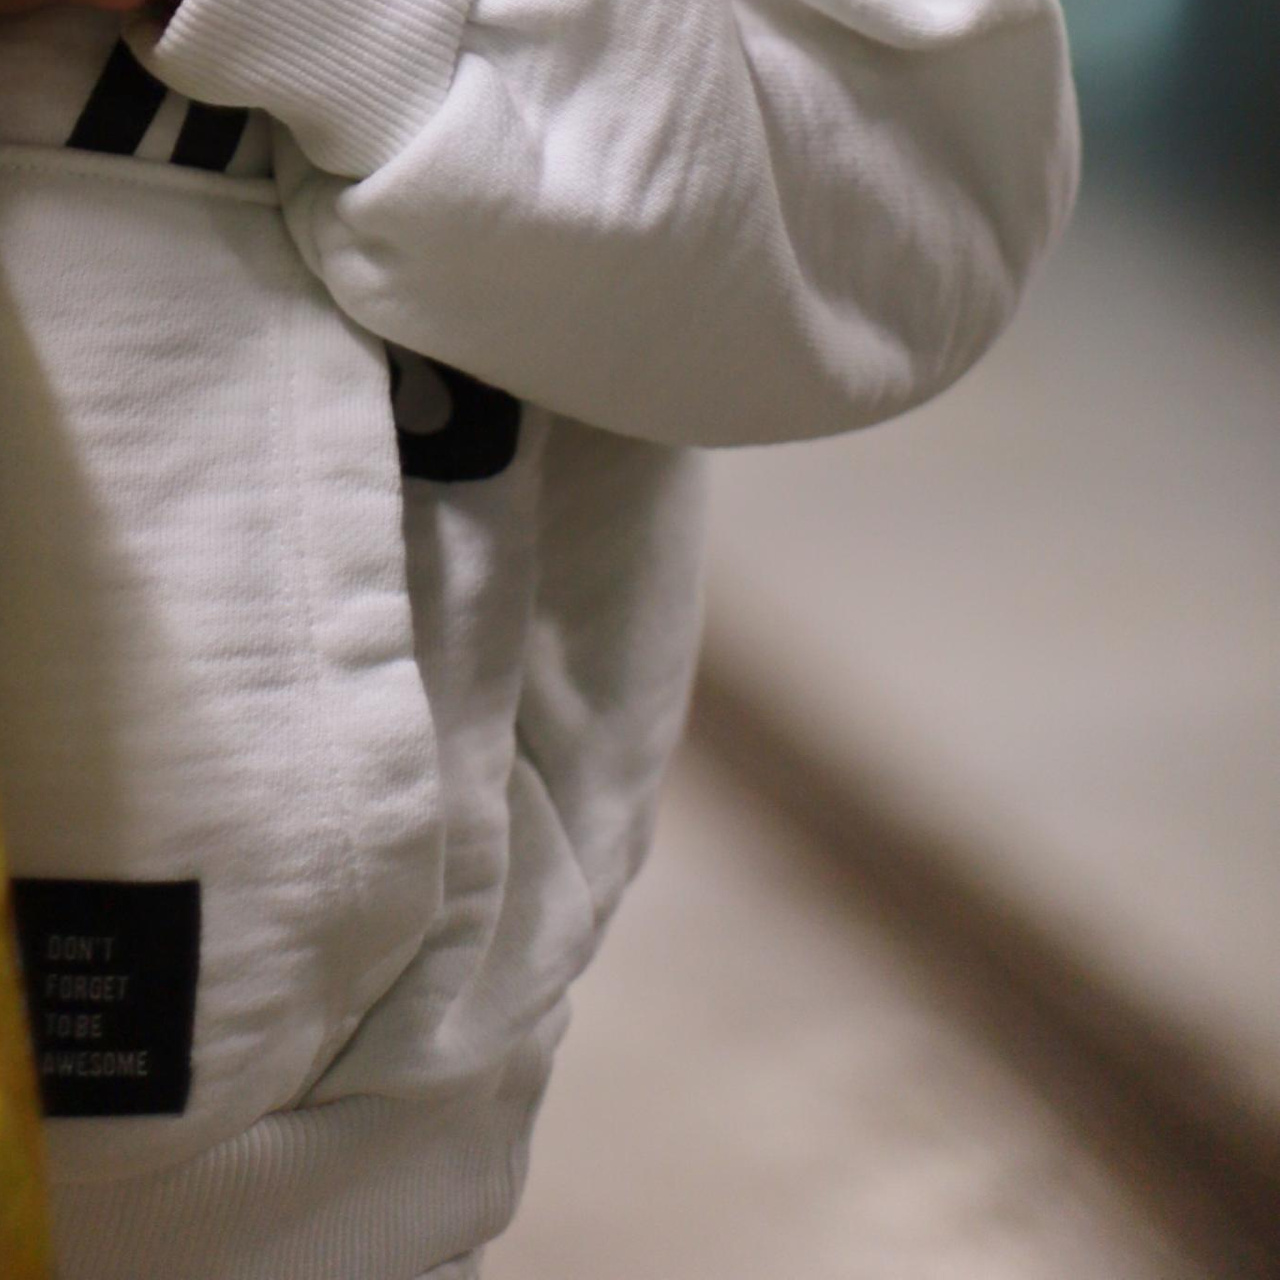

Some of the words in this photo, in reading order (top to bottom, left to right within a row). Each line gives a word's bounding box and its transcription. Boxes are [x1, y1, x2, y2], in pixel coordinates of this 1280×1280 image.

[46, 936, 114, 961] DON'T
[44, 974, 130, 1001] FORGET
[74, 1013, 104, 1038] BE
[41, 1050, 149, 1077] AWESOME
